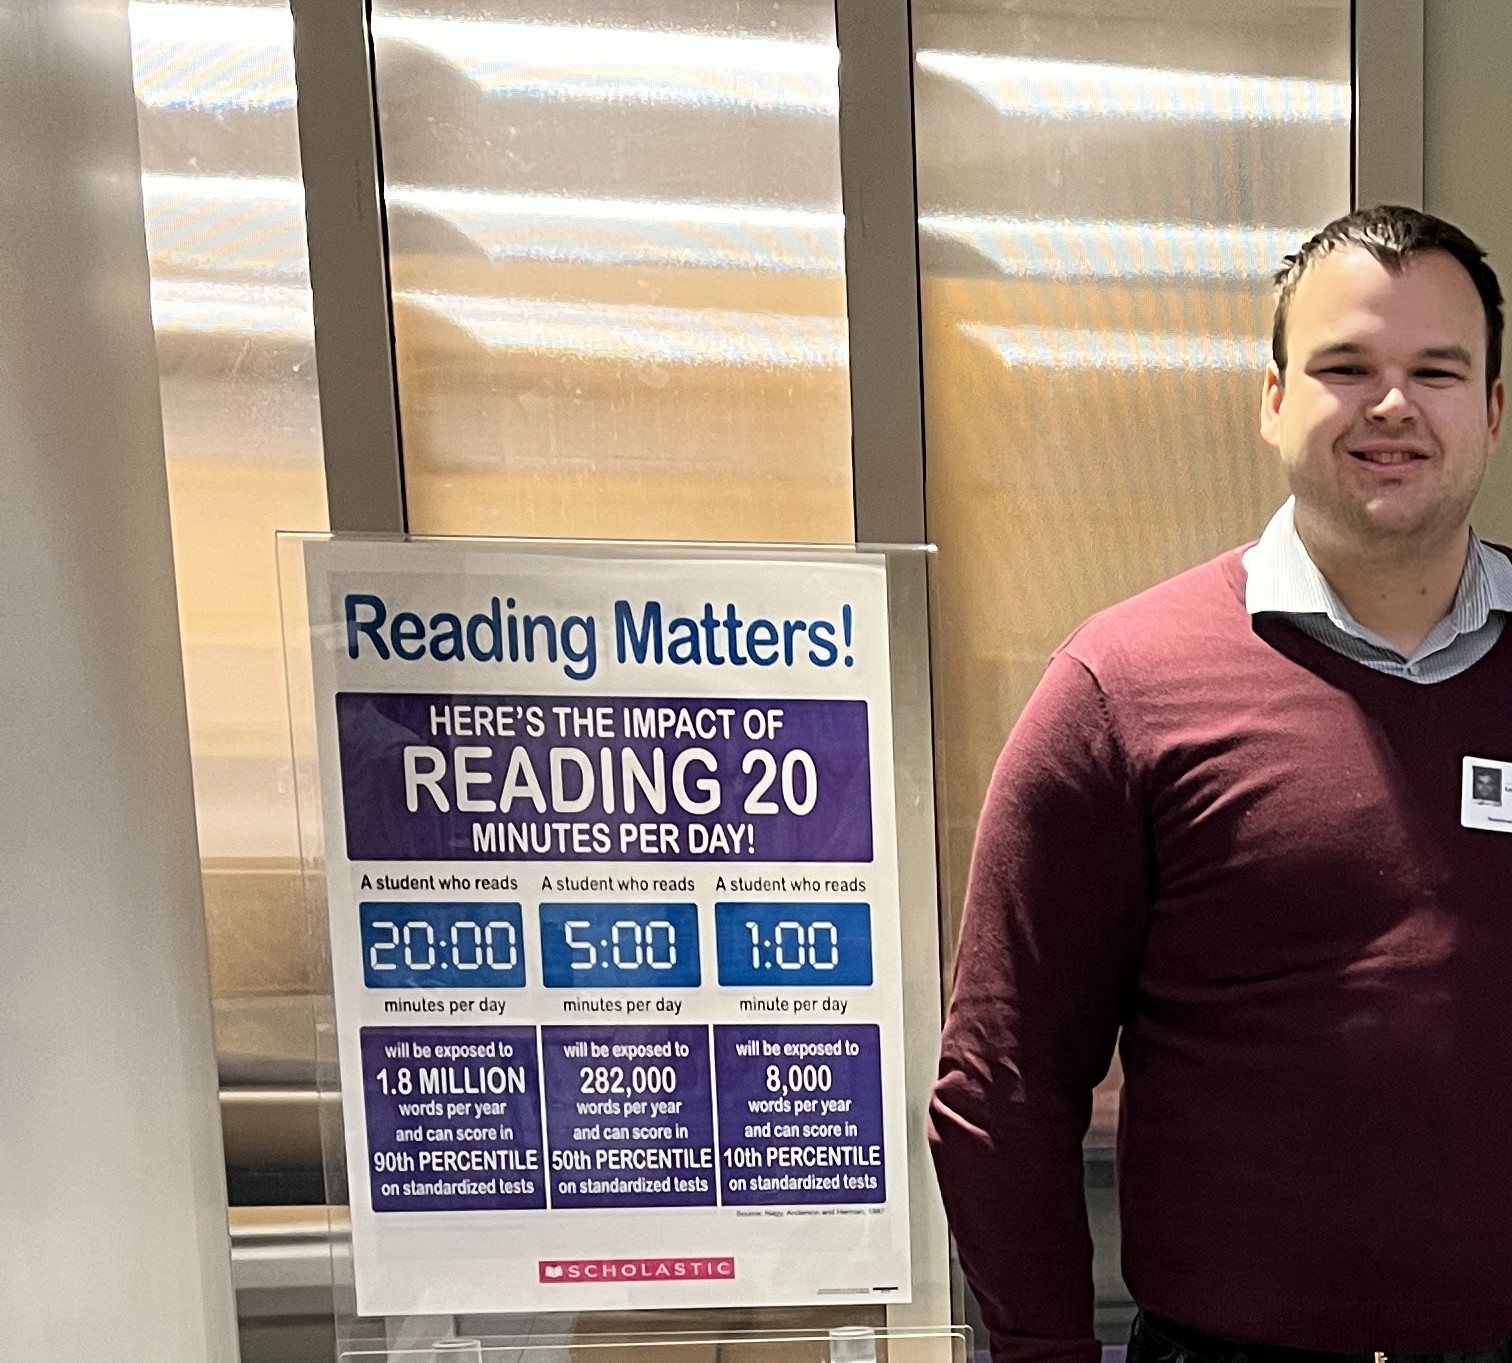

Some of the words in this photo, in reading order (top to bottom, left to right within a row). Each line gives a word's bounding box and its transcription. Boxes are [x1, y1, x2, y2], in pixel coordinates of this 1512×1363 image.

[345, 594, 596, 680] Reading
[615, 600, 853, 667] Matters!
[431, 706, 544, 737] HERE'S
[553, 707, 614, 737] THE
[624, 708, 735, 739] IMPACT
[744, 709, 783, 739] OF
[404, 746, 720, 814] READING
[743, 749, 817, 815] 20
[473, 823, 611, 853] MINUTES
[620, 824, 679, 853] PER
[689, 824, 754, 853] DAY!
[361, 875, 372, 889] A
[377, 875, 435, 890] student
[439, 875, 470, 890] who
[475, 876, 518, 890] reads
[542, 876, 552, 890] A
[557, 877, 614, 891] student
[618, 877, 648, 891] who
[654, 877, 694, 891] reads
[716, 877, 726, 890] A
[731, 877, 786, 891] student
[791, 877, 820, 891] who
[826, 878, 866, 891] reads
[371, 922, 516, 970] 20:00
[565, 921, 676, 969] 5:00
[746, 922, 838, 969] 1:00
[385, 998, 444, 1012] minutes
[450, 1001, 474, 1015] per
[479, 997, 505, 1015] day
[564, 998, 622, 1011] minutes
[627, 1001, 651, 1014] per
[656, 997, 681, 1015] day
[740, 997, 788, 1011] minute
[794, 1000, 817, 1014] per
[823, 997, 847, 1014] day
[385, 1042, 409, 1058] will
[413, 1043, 431, 1058] be
[435, 1042, 495, 1061] exposed
[499, 1042, 513, 1057] to
[564, 1042, 587, 1057] will
[591, 1042, 609, 1057] be
[612, 1042, 671, 1060] exposed
[675, 1042, 689, 1057] to
[736, 1040, 759, 1056] will
[763, 1040, 780, 1056] be
[784, 1040, 841, 1059] exposed
[845, 1040, 859, 1055] to
[377, 1068, 412, 1094] 1.8
[420, 1067, 525, 1094] MILLION
[580, 1067, 675, 1098] 282,000
[767, 1065, 831, 1096] 8,000
[399, 1100, 443, 1115] words
[447, 1103, 471, 1119] per
[475, 1103, 506, 1119] year
[577, 1099, 620, 1114] words
[624, 1102, 647, 1118] per
[651, 1102, 682, 1118] year
[748, 1097, 791, 1112] words
[796, 1100, 818, 1116] per
[821, 1100, 852, 1115] year
[396, 1126, 422, 1141] and
[427, 1129, 453, 1141] can
[457, 1128, 496, 1140] score
[500, 1124, 513, 1140] in
[574, 1124, 600, 1140] and
[604, 1128, 629, 1139] can
[633, 1127, 671, 1139] score
[676, 1123, 688, 1138] in
[745, 1122, 770, 1137] and
[774, 1125, 799, 1137] can
[803, 1125, 841, 1137] score
[845, 1121, 857, 1136] in
[374, 1152, 414, 1172] 90th
[419, 1150, 538, 1171] PERCENTILE
[553, 1150, 591, 1170] 50th
[596, 1148, 712, 1169] PERCENTILE
[724, 1148, 762, 1167] 10th
[767, 1146, 881, 1167] PERCENTILE
[382, 1184, 399, 1195] on
[403, 1179, 496, 1195] standardized
[500, 1179, 534, 1193] tests
[559, 1182, 576, 1193] on
[580, 1177, 670, 1193] standardized
[674, 1177, 708, 1192] tests
[729, 1179, 746, 1191] on
[750, 1174, 840, 1190] standardized
[843, 1174, 877, 1189] tests
[568, 1261, 732, 1280] SCHOLASTIC
